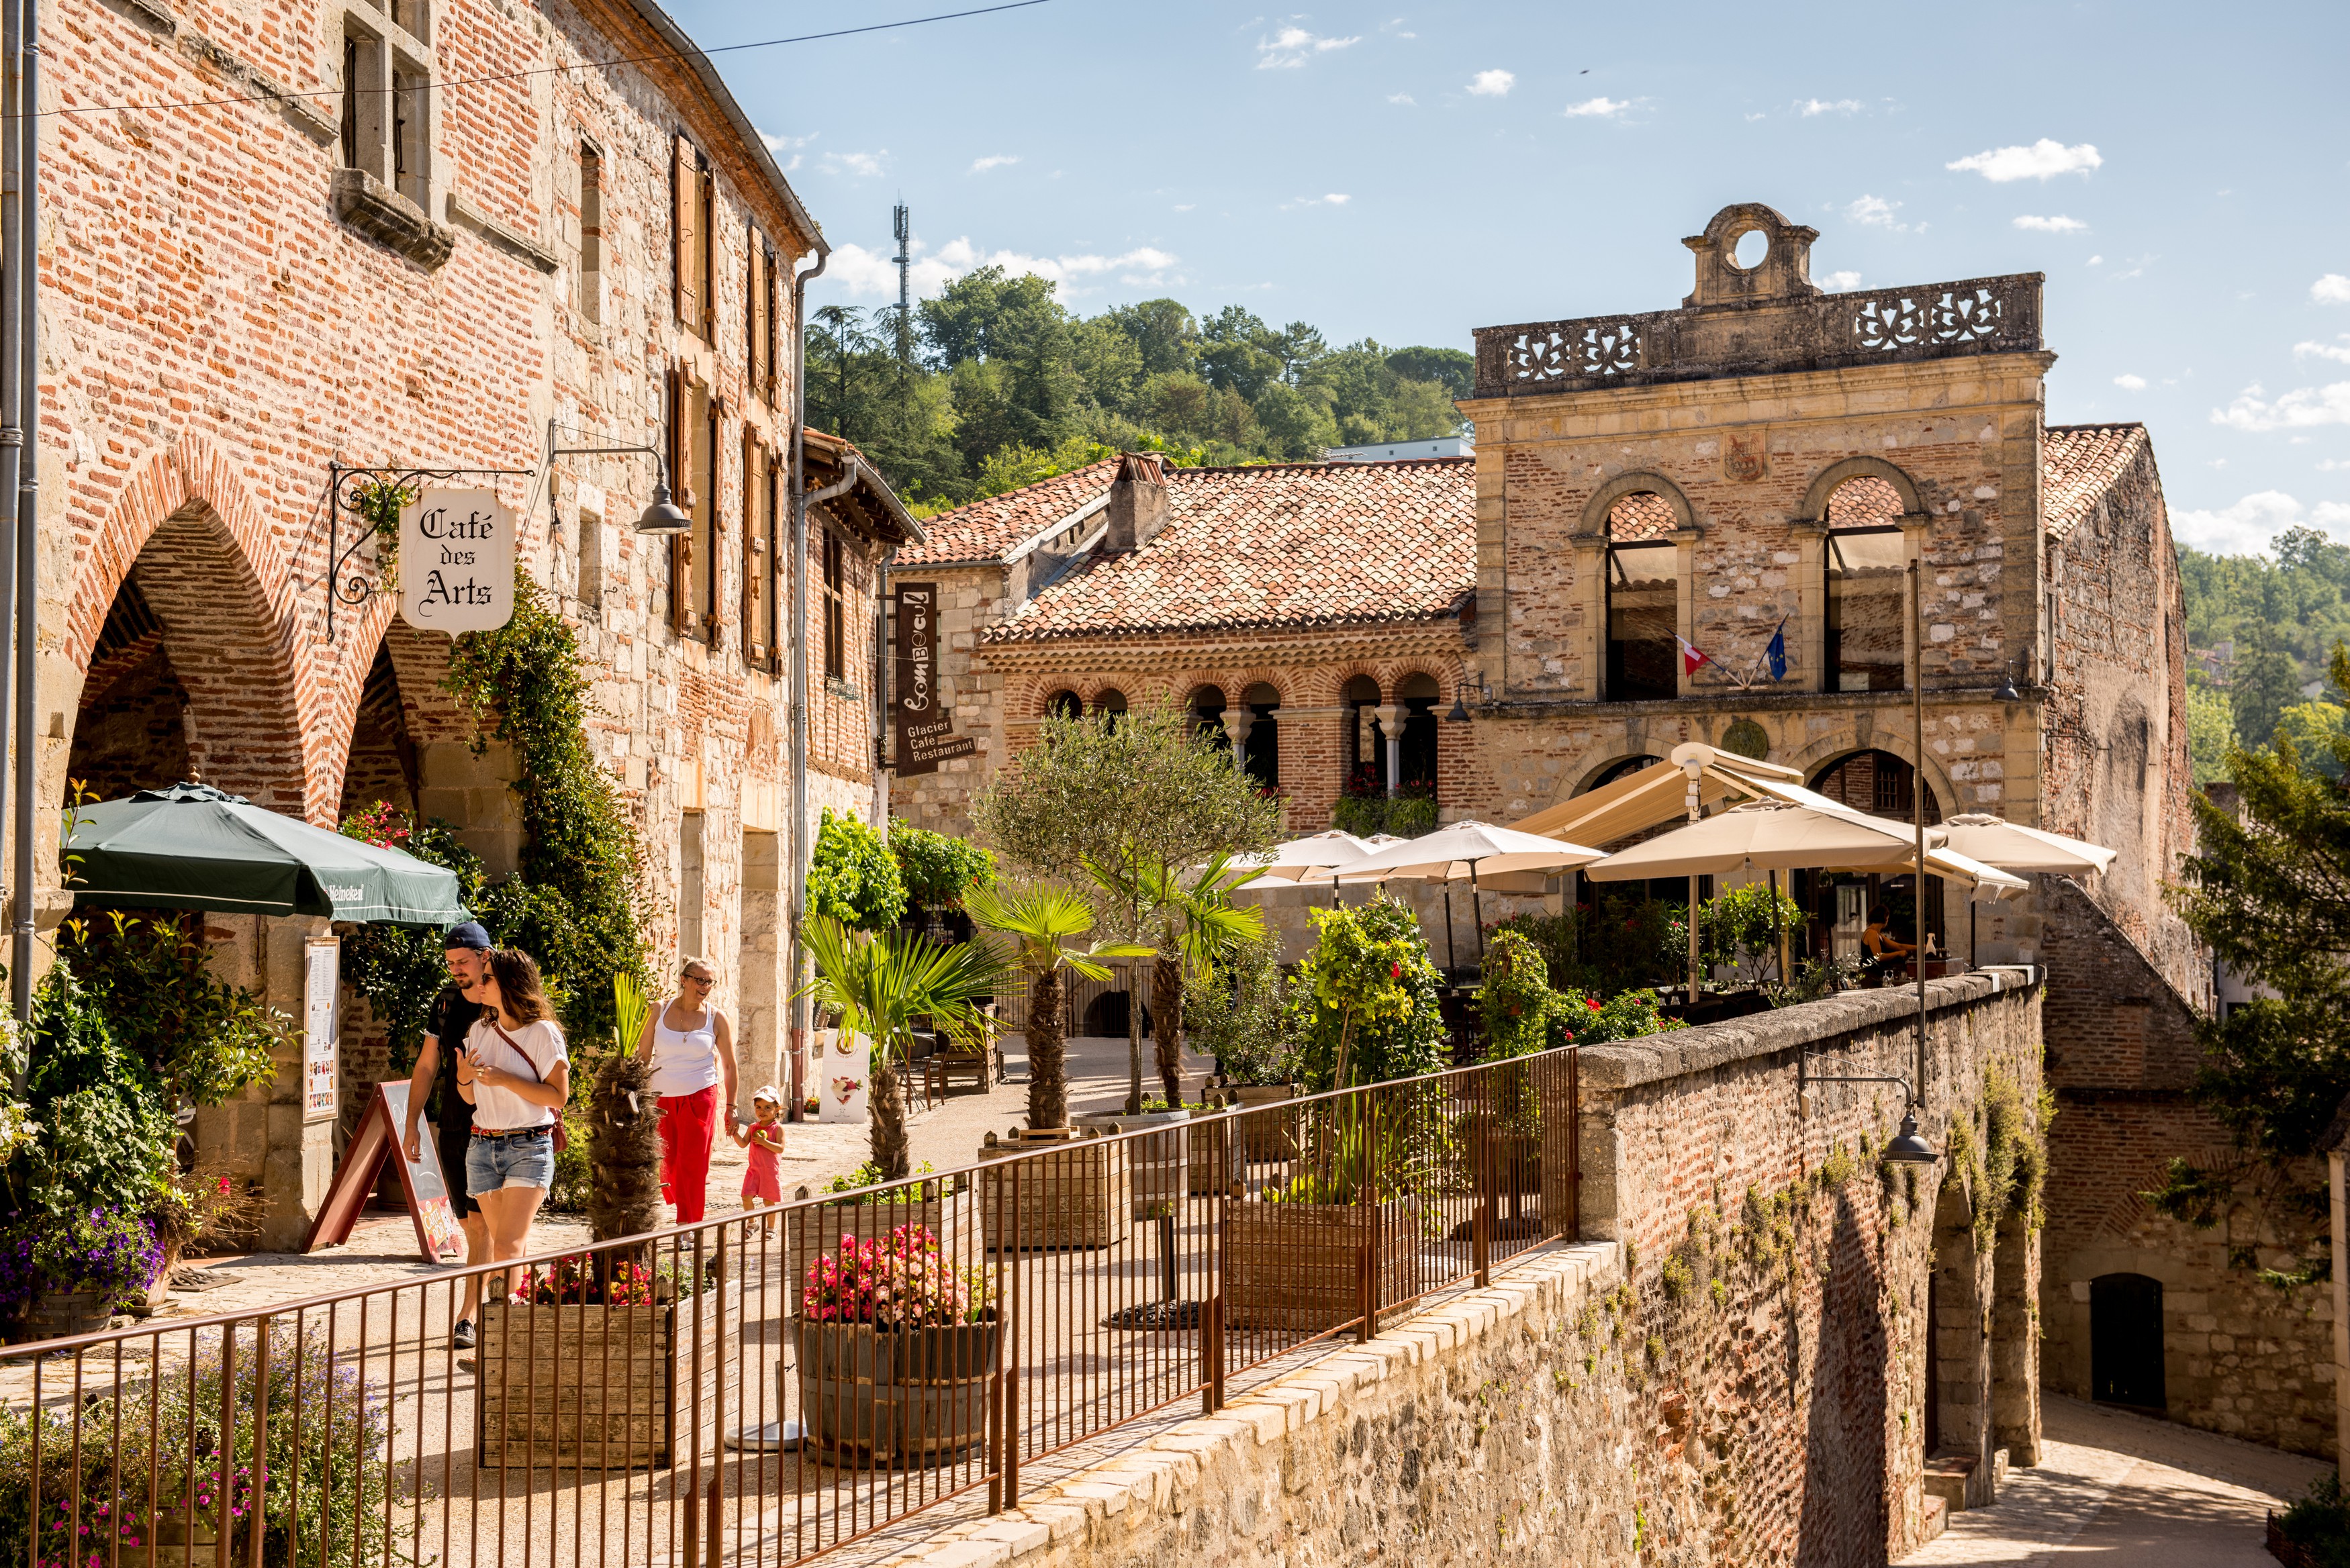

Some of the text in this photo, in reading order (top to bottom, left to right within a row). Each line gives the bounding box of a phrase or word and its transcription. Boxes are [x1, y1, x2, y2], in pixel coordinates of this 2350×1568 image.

[420, 508, 493, 540] Café
[439, 544, 476, 565] des
[418, 569, 493, 617] Arts
[907, 722, 948, 738] Glacier
[910, 735, 935, 750] Café
[913, 740, 973, 762] Restaurant
[328, 884, 364, 901] Heineken
[424, 1208, 440, 1230] CARTE
